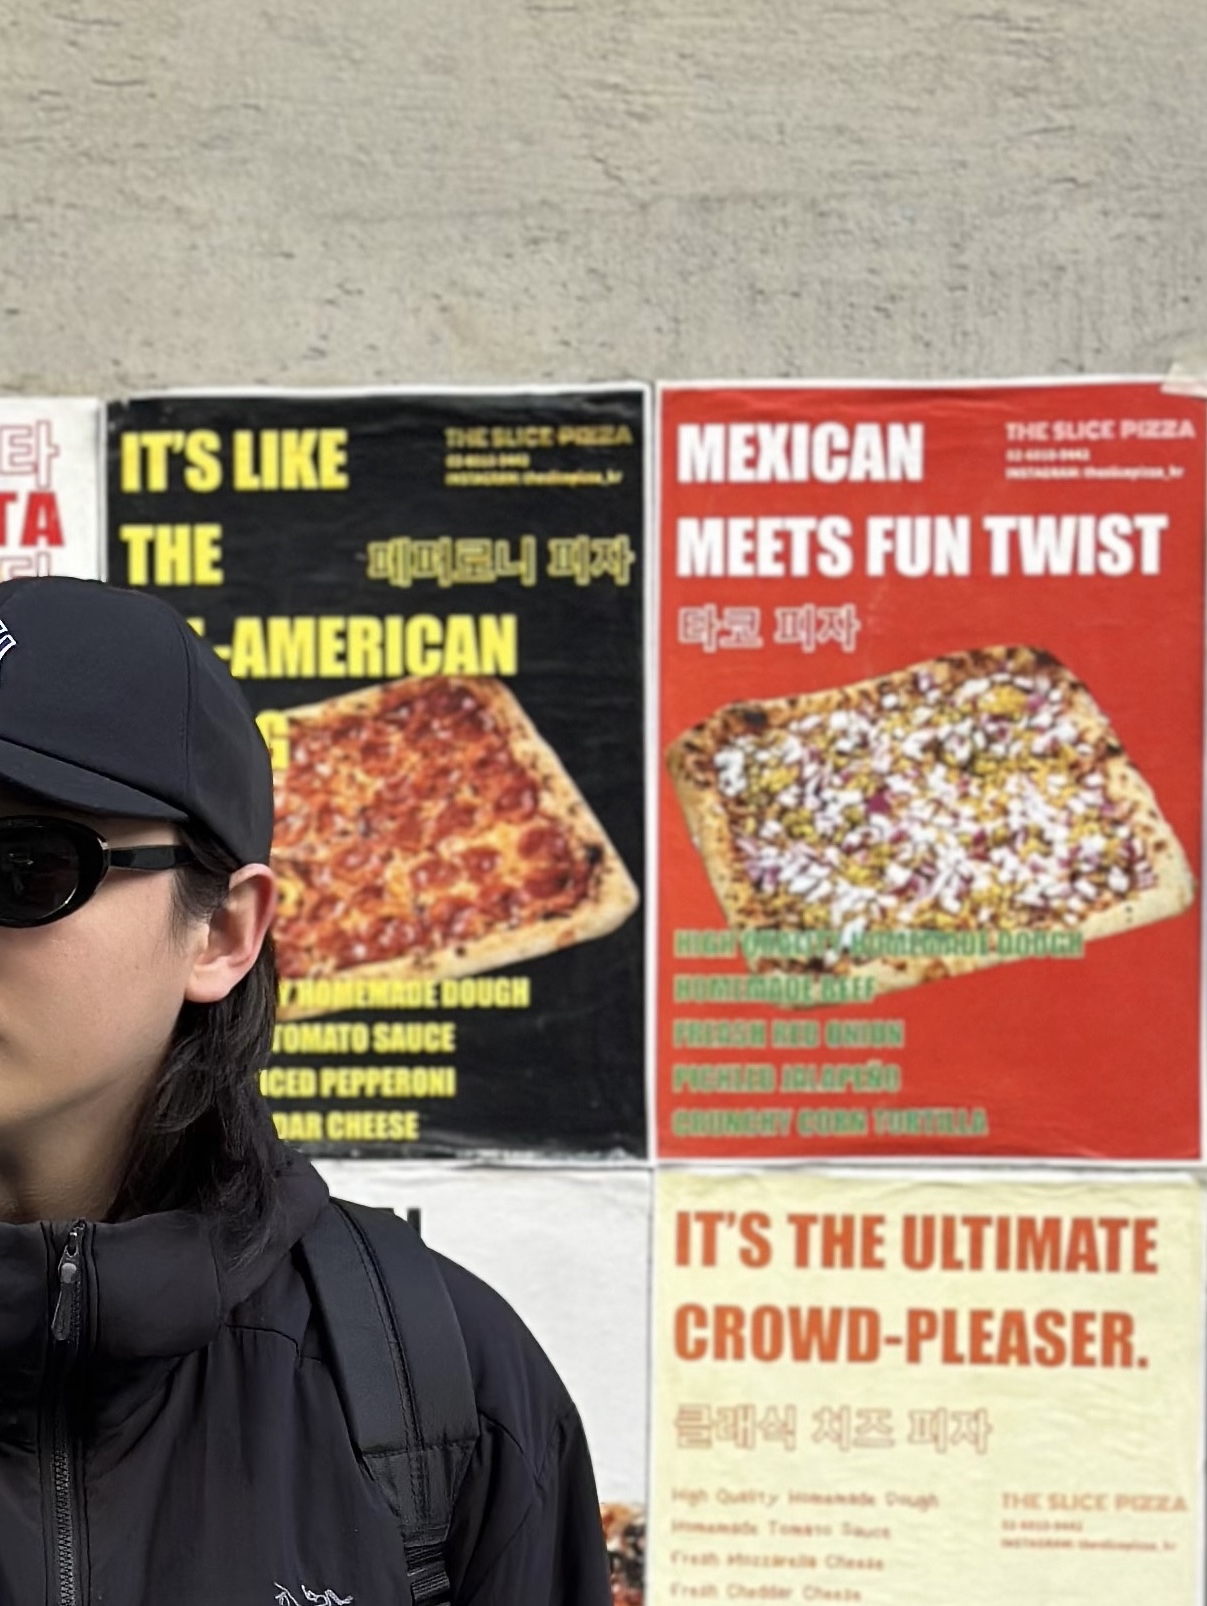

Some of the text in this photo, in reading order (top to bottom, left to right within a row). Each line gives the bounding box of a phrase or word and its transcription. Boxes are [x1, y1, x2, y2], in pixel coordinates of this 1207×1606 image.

[677, 422, 924, 483] MEXICAN
[1005, 418, 1197, 441] THE SLICE PIZZA
[120, 427, 349, 493] IT'S LIKE
[120, 524, 223, 586] THE
[547, 534, 636, 587] 피자
[676, 514, 1169, 578] MEETS FUN TWIST
[677, 602, 860, 652] 타코 피자
[295, 978, 440, 1008] HOMEMADE
[442, 977, 530, 1008] DOUGH
[373, 1021, 457, 1054] SAUCE
[771, 1018, 820, 1049] RED
[825, 1018, 905, 1049] ONION
[320, 1065, 457, 1097] PEPPERONI
[326, 1110, 420, 1141] CHEESE
[672, 1108, 794, 1138] CRUNCHY
[797, 1107, 869, 1137] CORN
[675, 1211, 1159, 1274] IT'S THE ULTIMATE
[673, 1302, 1149, 1369] CROWD-PLEASER.
[673, 1403, 995, 1455] 클래식 치즈 피자
[1001, 1493, 1189, 1512] THE SLICE PIZZA
